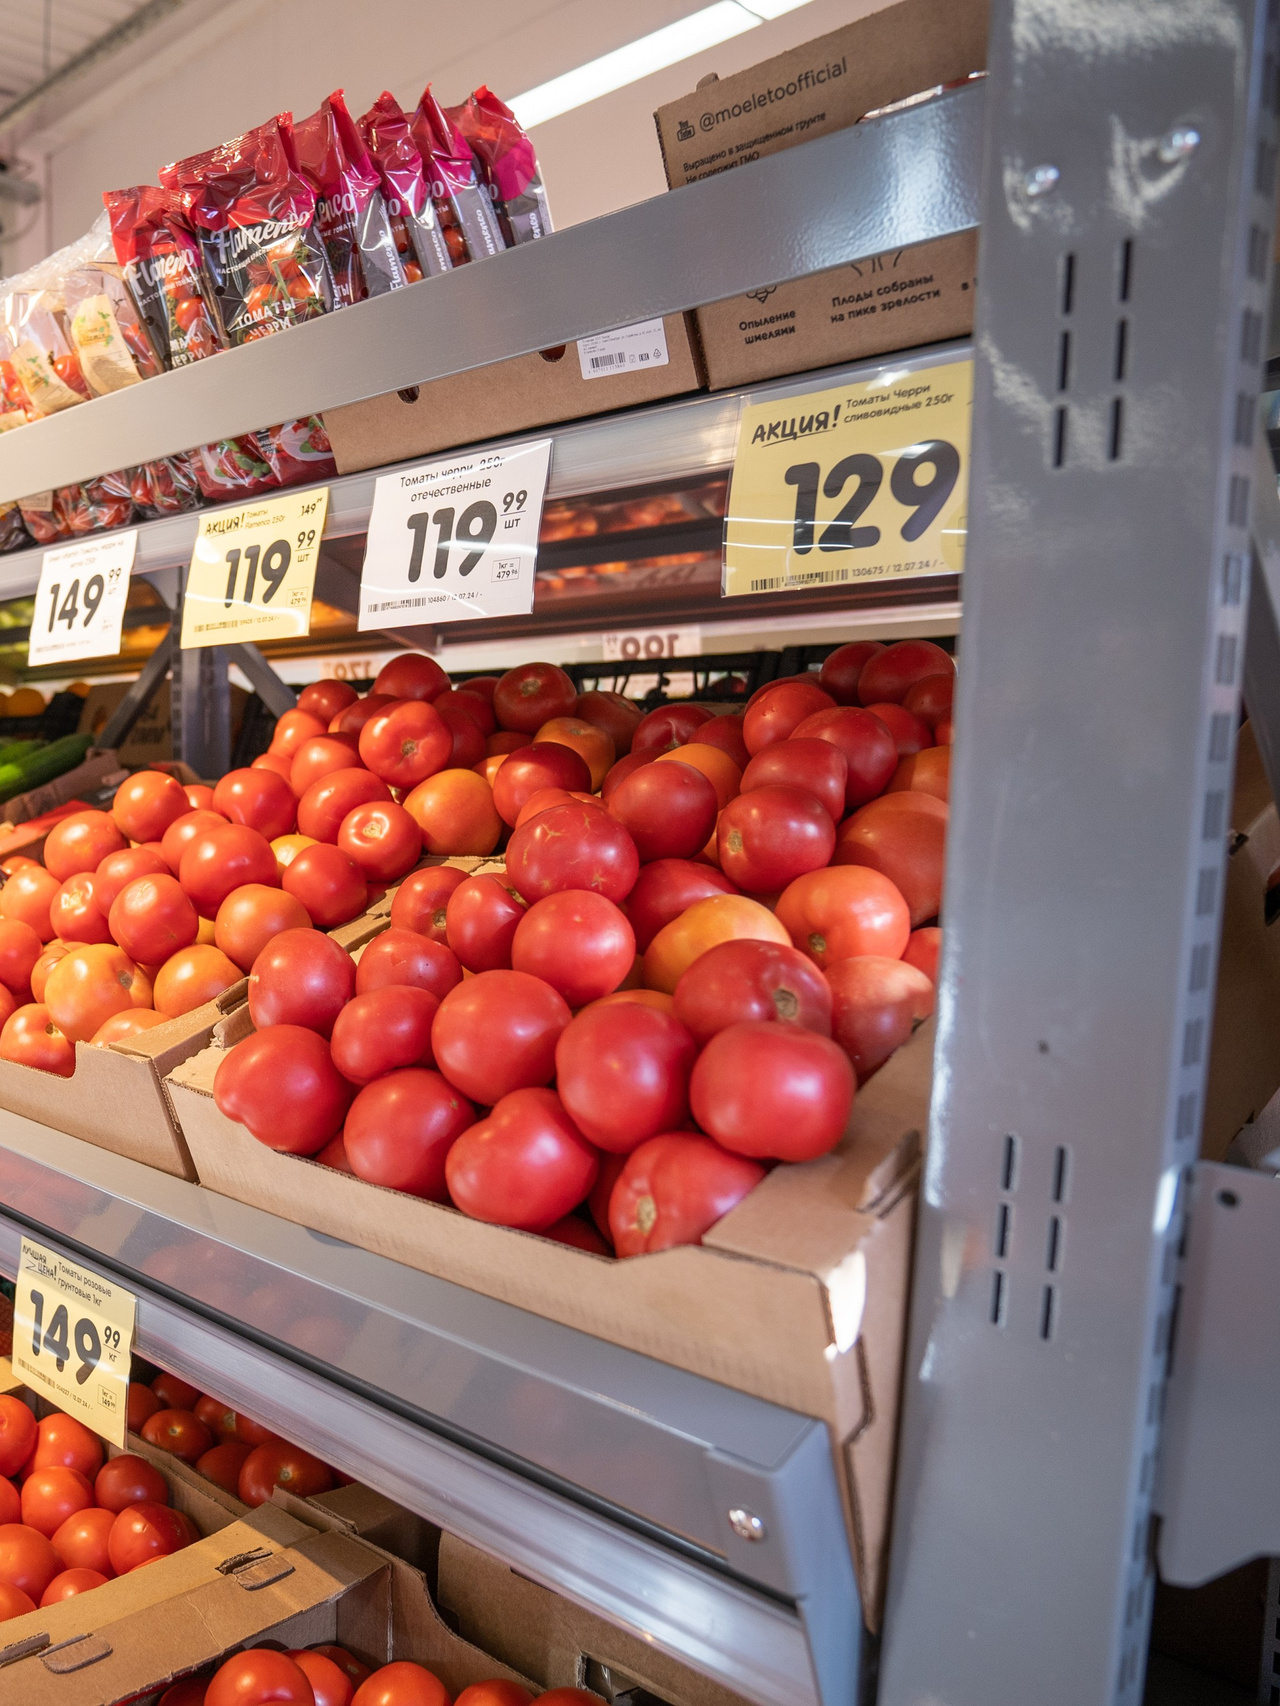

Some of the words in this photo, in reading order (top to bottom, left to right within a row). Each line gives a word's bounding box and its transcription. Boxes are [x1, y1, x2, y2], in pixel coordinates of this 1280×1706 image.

[699, 56, 847, 132] @moeletoofficial
[683, 150, 727, 172] Выращено
[735, 126, 793, 154] защищенном
[795, 112, 826, 132] грунте
[739, 151, 760, 166] ГМО
[476, 209, 496, 255] amenco
[379, 229, 403, 291] Flameno
[832, 289, 873, 308] Плоды
[877, 274, 934, 296] собраны
[237, 298, 296, 327] ТОМАТЫ
[830, 312, 845, 324] на
[848, 305, 877, 319] пике
[881, 289, 941, 312] зрелости
[250, 316, 292, 338] ЧЕРРИ
[739, 309, 796, 331] Опыление
[745, 325, 796, 344] шмелями
[843, 400, 922, 424] сливовидные
[924, 393, 955, 408] 250г
[846, 392, 890, 409] Томаты
[893, 384, 931, 401] Черри
[751, 404, 842, 445] АКЦИЯ!
[400, 471, 439, 489] Томаты
[411, 478, 491, 502] отечественные
[503, 489, 528, 513] 99
[784, 439, 961, 555] 129
[247, 509, 268, 519] Томаты
[300, 503, 316, 516] 149
[205, 512, 245, 536] АКЦИЯ!
[504, 517, 520, 529] шт
[297, 529, 315, 548] 99
[407, 500, 497, 583] 119
[108, 567, 122, 583] 99
[224, 539, 291, 608] 119
[496, 570, 510, 579] 479
[852, 566, 883, 577] 130675
[893, 560, 930, 573] 12.07.24
[48, 574, 105, 633] 149
[452, 592, 475, 601] 1207.24
[22, 1244, 46, 1264] ЛУЧШАЯ
[38, 1263, 57, 1280] ЦЕНА!
[58, 1261, 82, 1281] Томаты
[84, 1277, 111, 1297] розовые
[58, 1278, 91, 1301] грунтовые
[30, 1289, 102, 1385] 149
[103, 1326, 121, 1349] 99
[109, 1352, 117, 1362] кг
